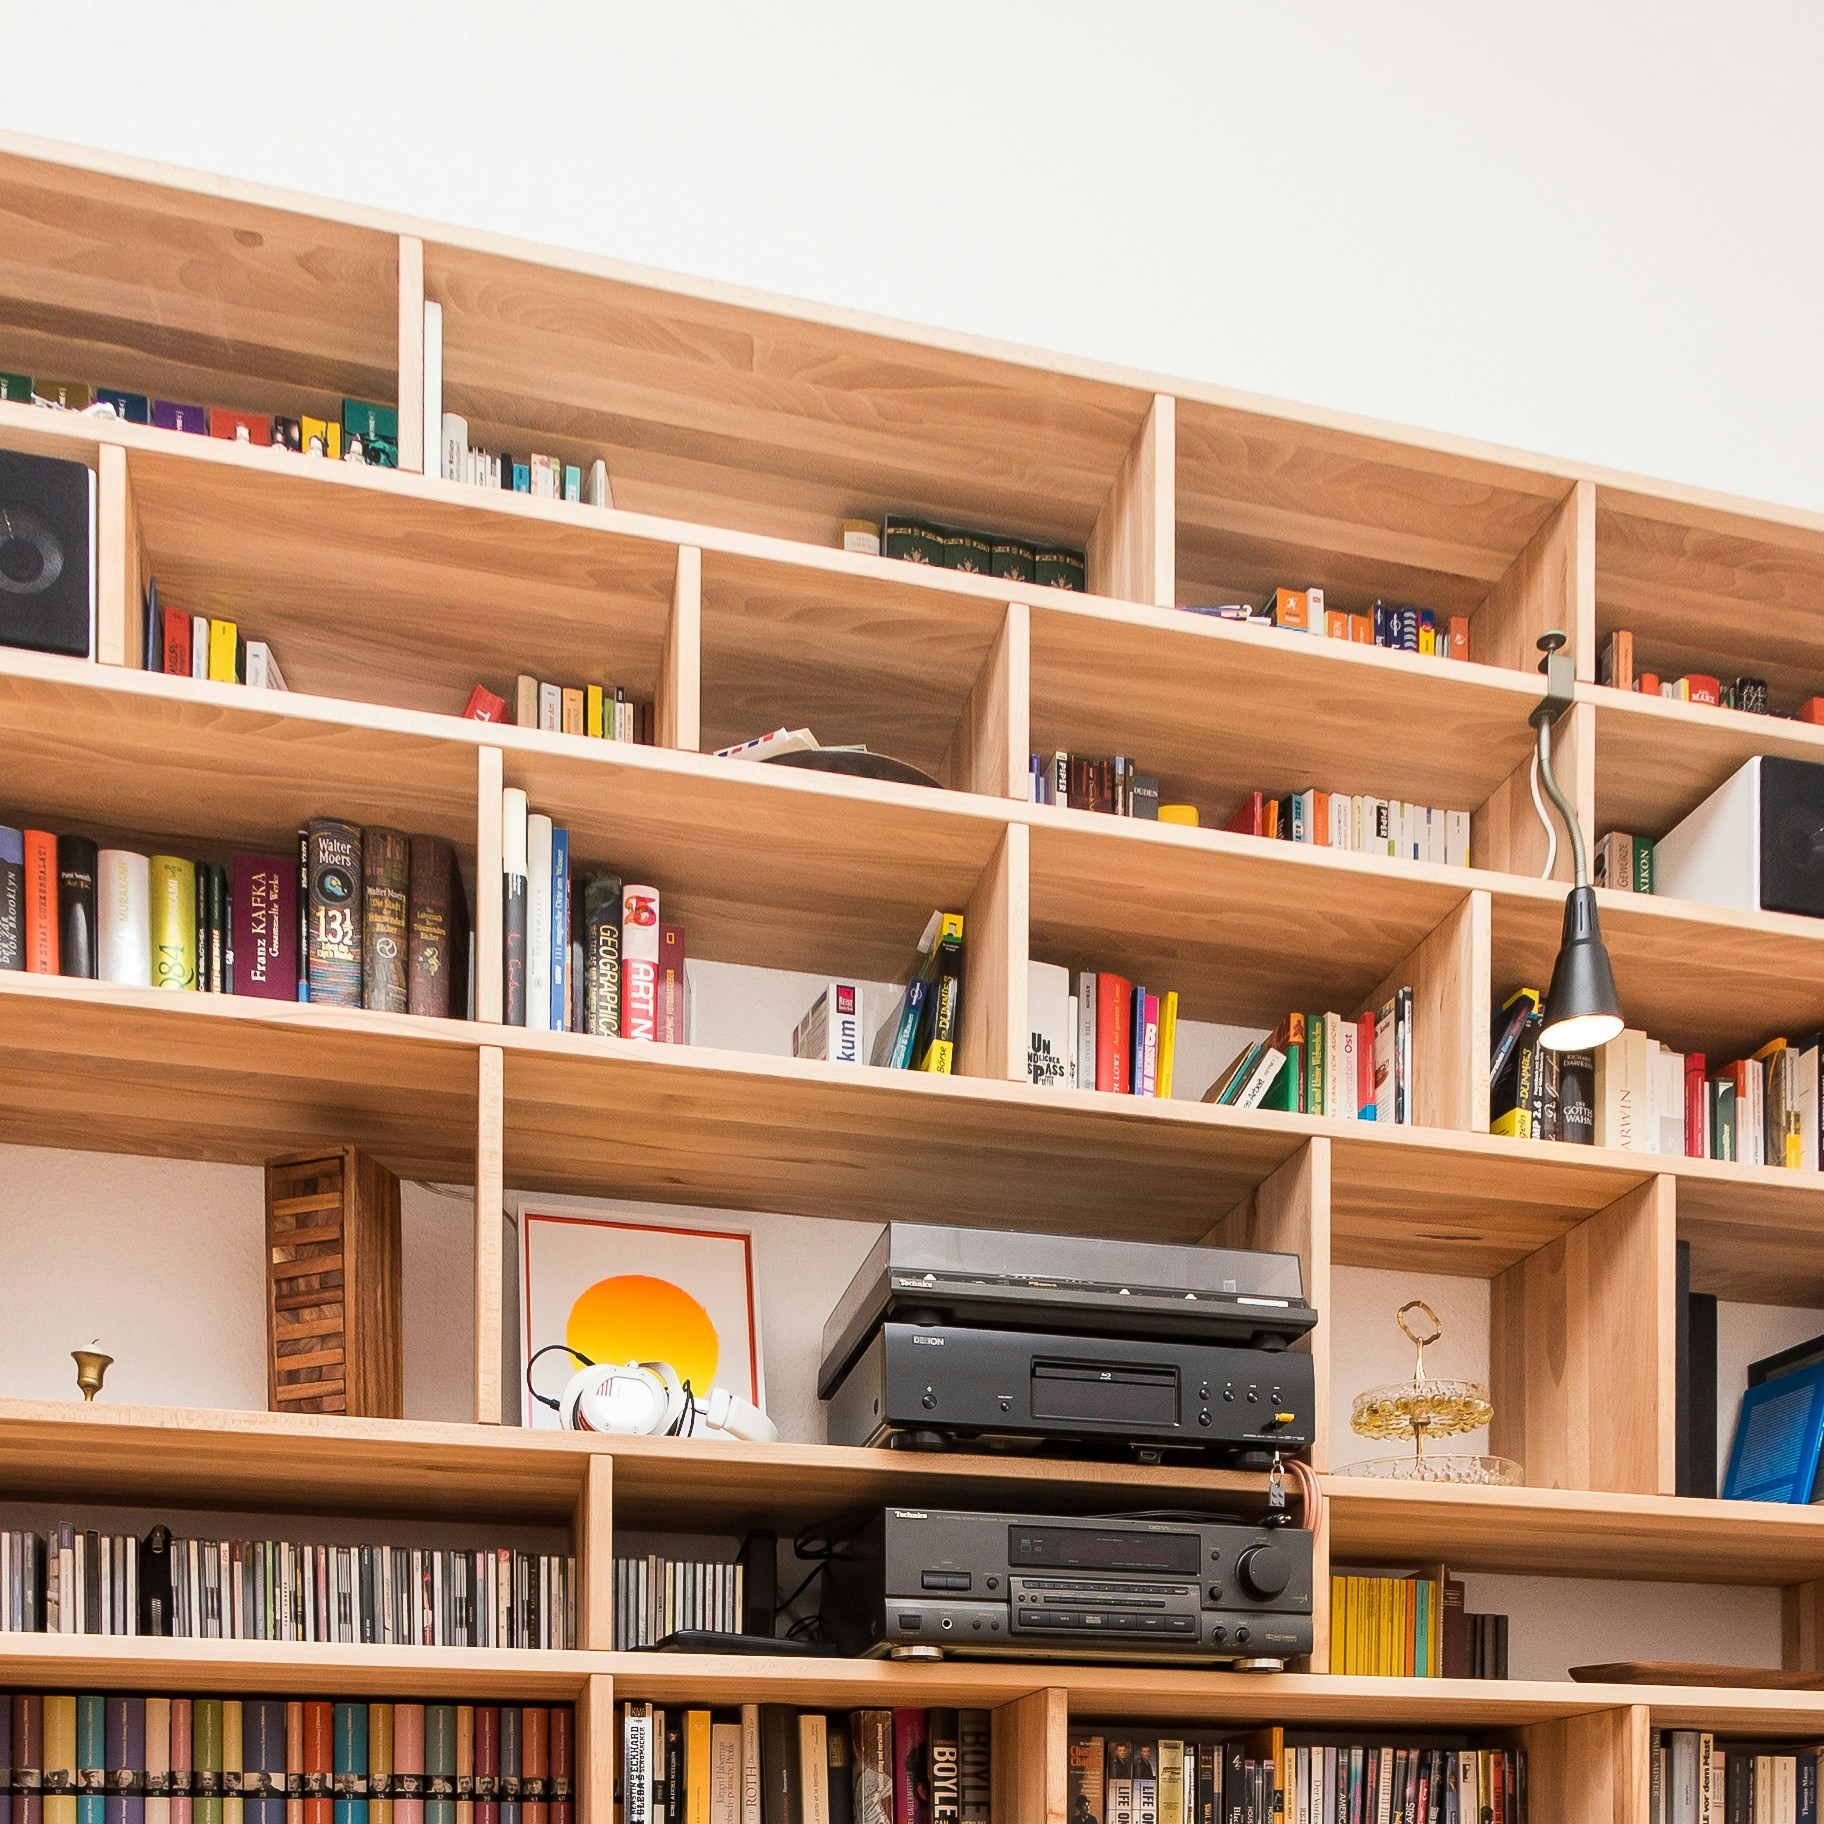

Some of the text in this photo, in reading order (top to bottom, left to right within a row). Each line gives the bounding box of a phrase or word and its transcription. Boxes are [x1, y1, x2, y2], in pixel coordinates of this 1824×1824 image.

[1133, 786, 1158, 798] DUDEN
[318, 837, 351, 855] Walter
[318, 849, 352, 867] Moers
[1640, 848, 1650, 894] XIKON
[118, 862, 130, 923] MURAKAMI
[250, 871, 267, 982] Franz KAFKA
[598, 924, 618, 1038] GEOGRAPHICA
[936, 1045, 947, 1073] Börse
[1344, 1032, 1354, 1113] Generation Ost
[1619, 1088, 1632, 1151] ARWIN
[898, 1279, 933, 1288] Technics
[913, 1335, 944, 1346] DENON
[894, 1510, 928, 1519] Technics
[629, 1726, 639, 1773] ECKHARD
[933, 1746, 958, 1818] BOYLE
[961, 1730, 989, 1816] BOYLE
[1117, 1785, 1129, 1807] LIFE
[1141, 1785, 1154, 1807] LIFE
[1313, 1779, 1321, 1797] Der
[1494, 1786, 1503, 1810] LIVING
